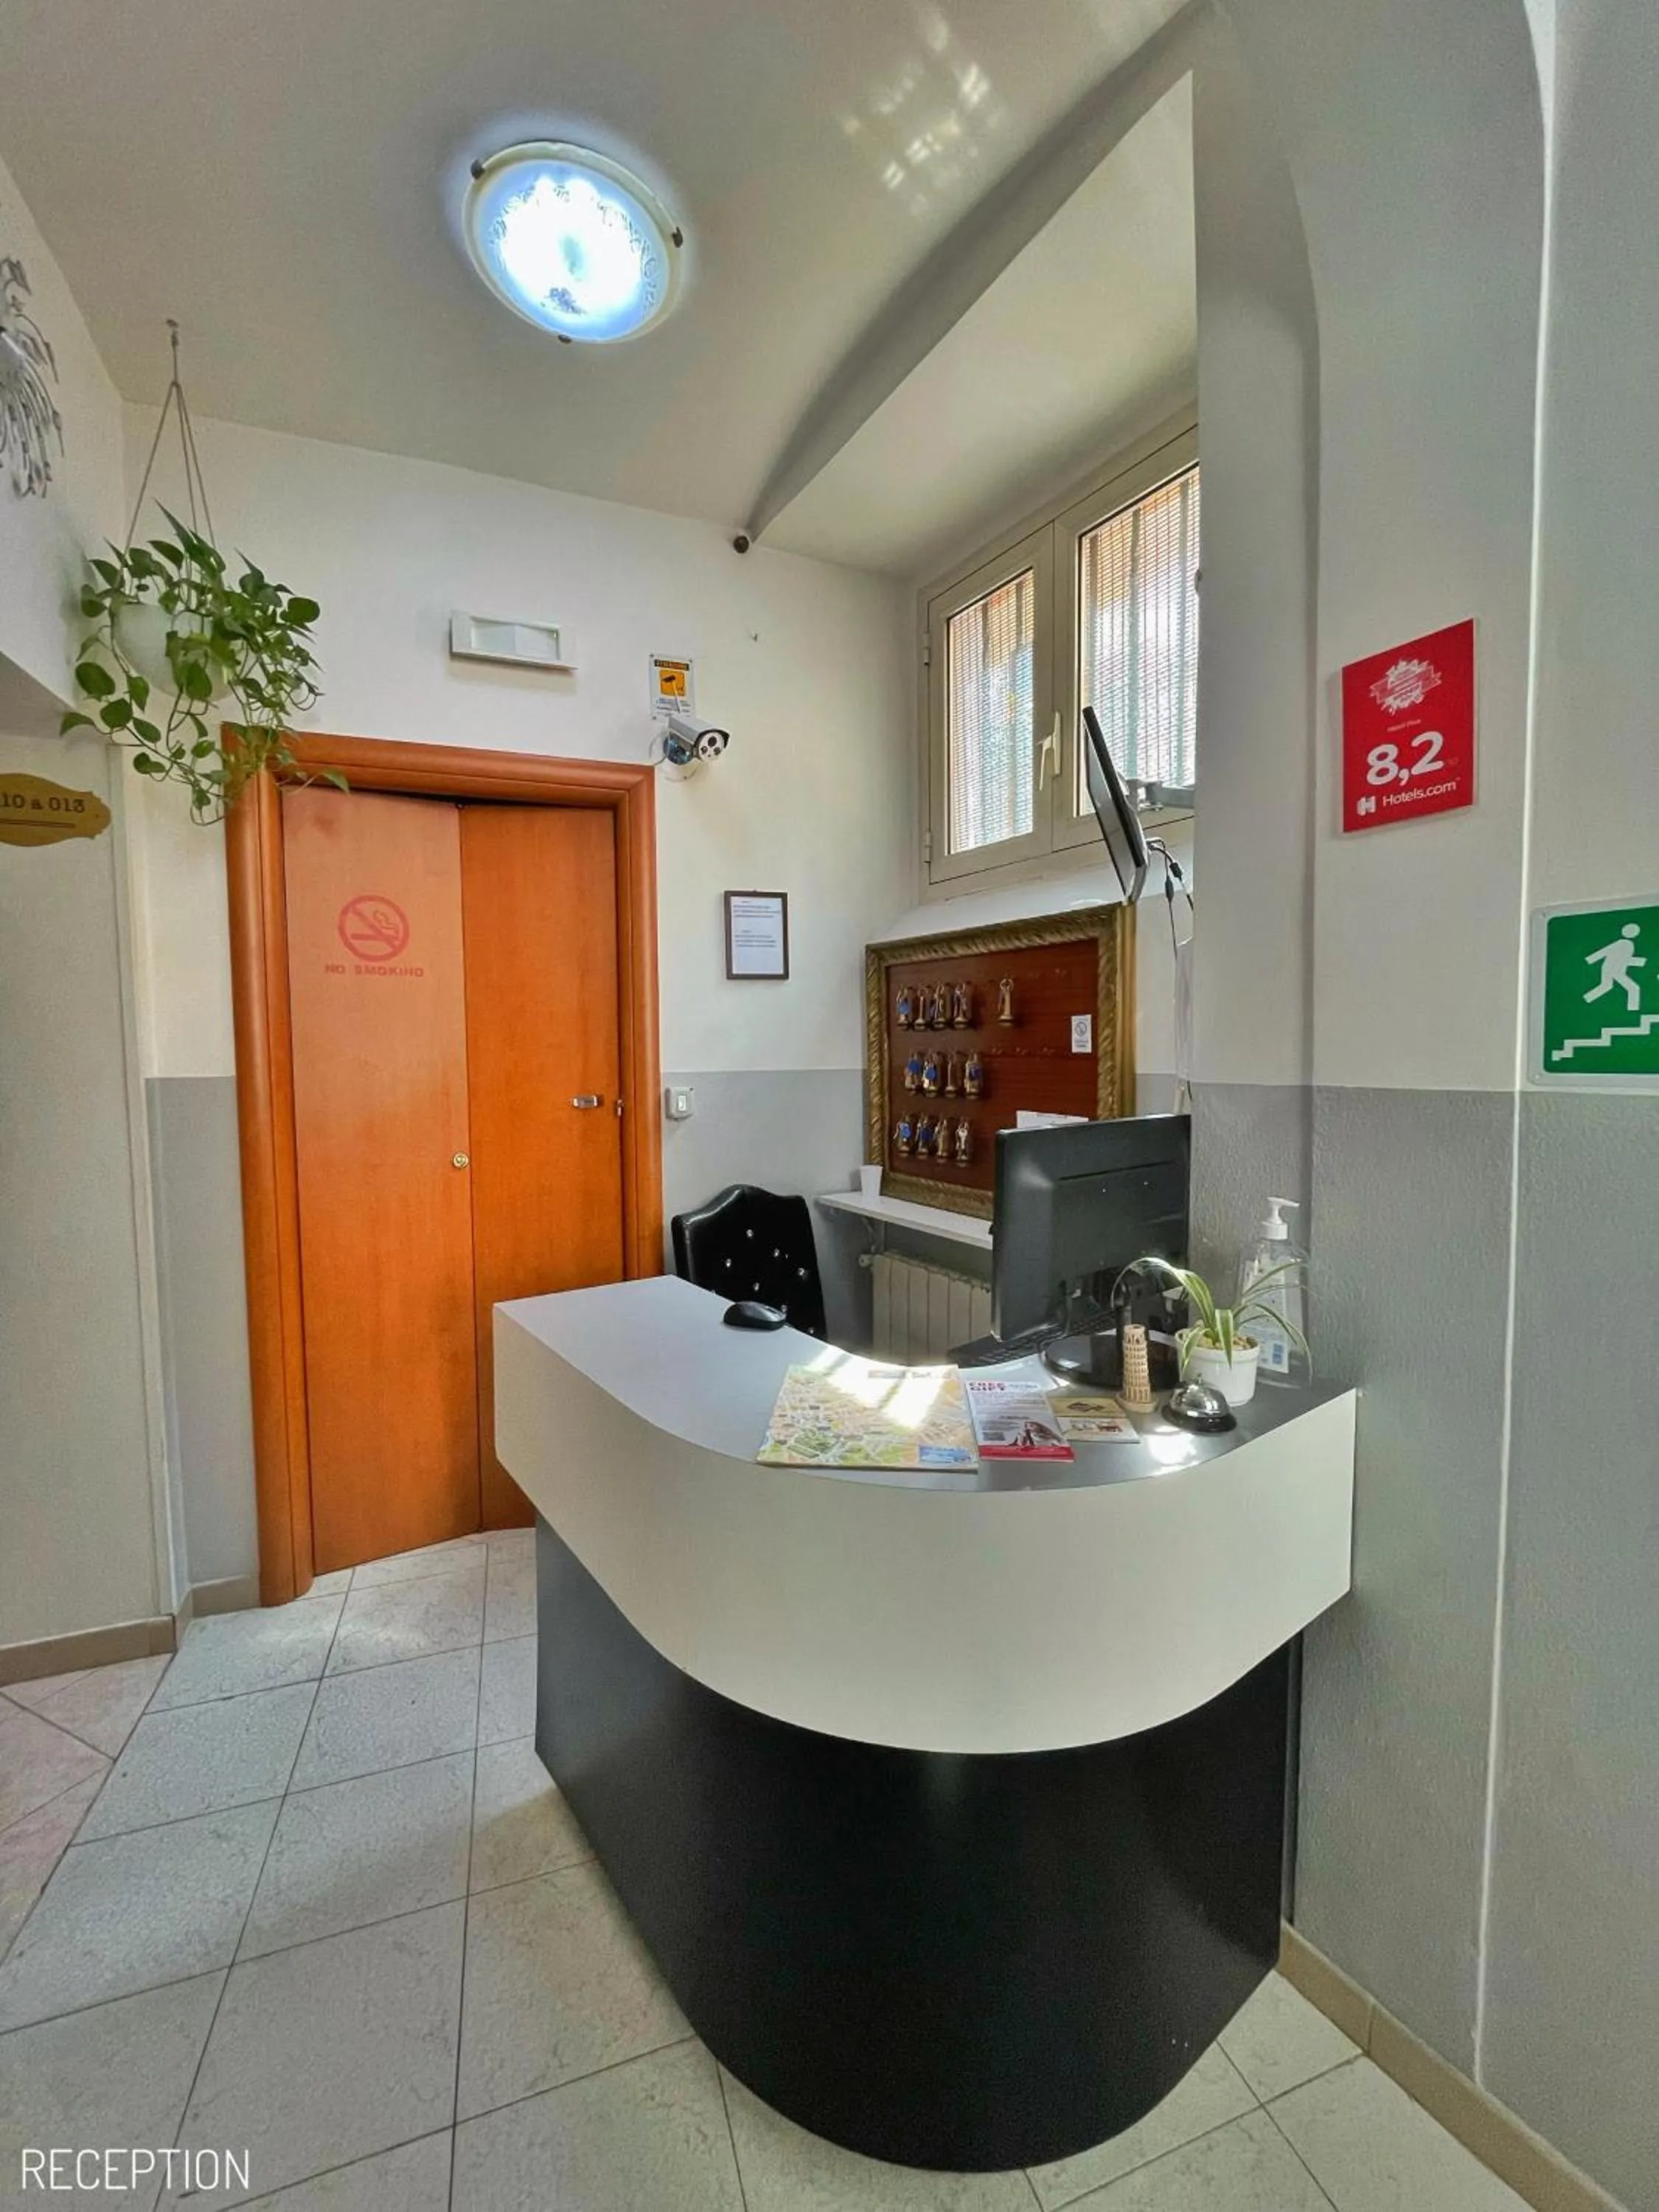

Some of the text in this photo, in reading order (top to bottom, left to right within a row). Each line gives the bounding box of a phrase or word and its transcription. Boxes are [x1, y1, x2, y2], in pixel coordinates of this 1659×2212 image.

[1366, 731, 1444, 786] 8,2
[49, 796, 86, 813] 013
[1382, 781, 1456, 807] Hotels.com
[324, 964, 425, 977] NO SMOKING
